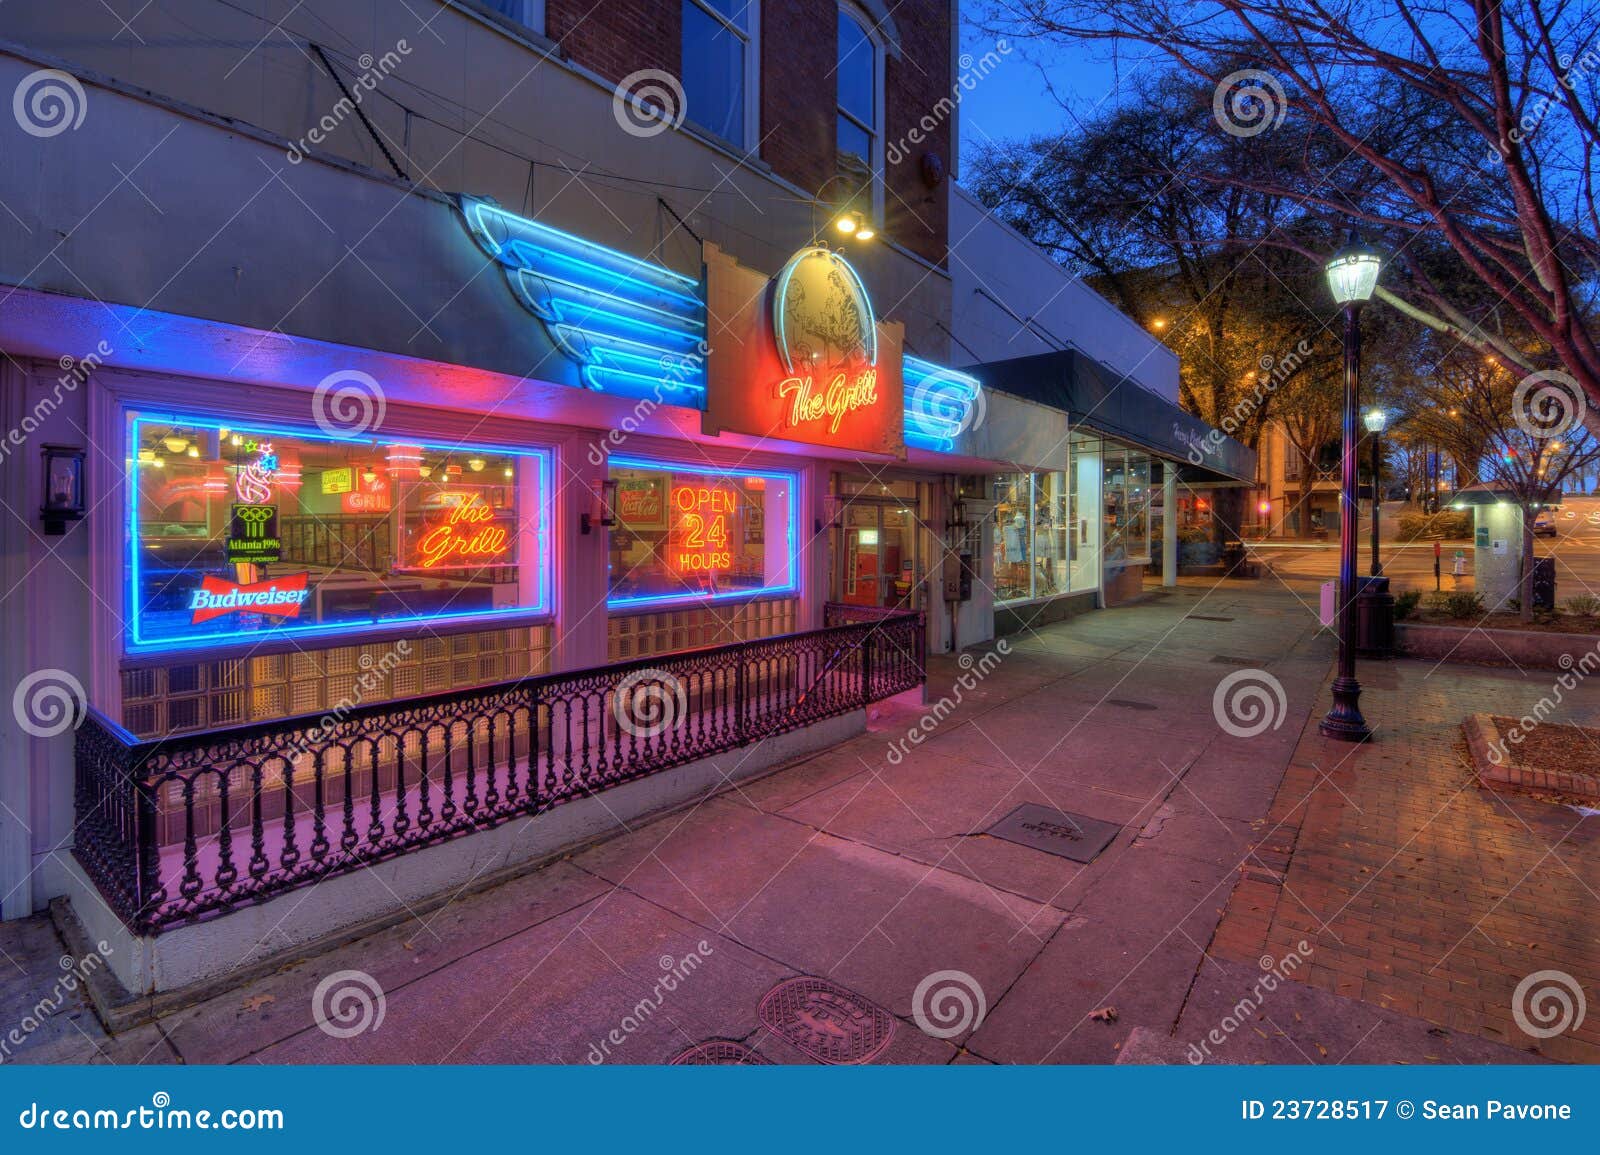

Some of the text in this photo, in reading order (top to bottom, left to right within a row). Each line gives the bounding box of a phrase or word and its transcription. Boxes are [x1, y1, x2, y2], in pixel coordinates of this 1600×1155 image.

[779, 368, 878, 434] The Grill
[440, 492, 494, 525] The
[677, 487, 737, 514] OPEN
[229, 538, 281, 550] Atlanta 1996
[685, 513, 727, 549] 24
[423, 526, 508, 568] Grill
[679, 552, 731, 571] HOURS
[188, 586, 308, 610] Budweiser
